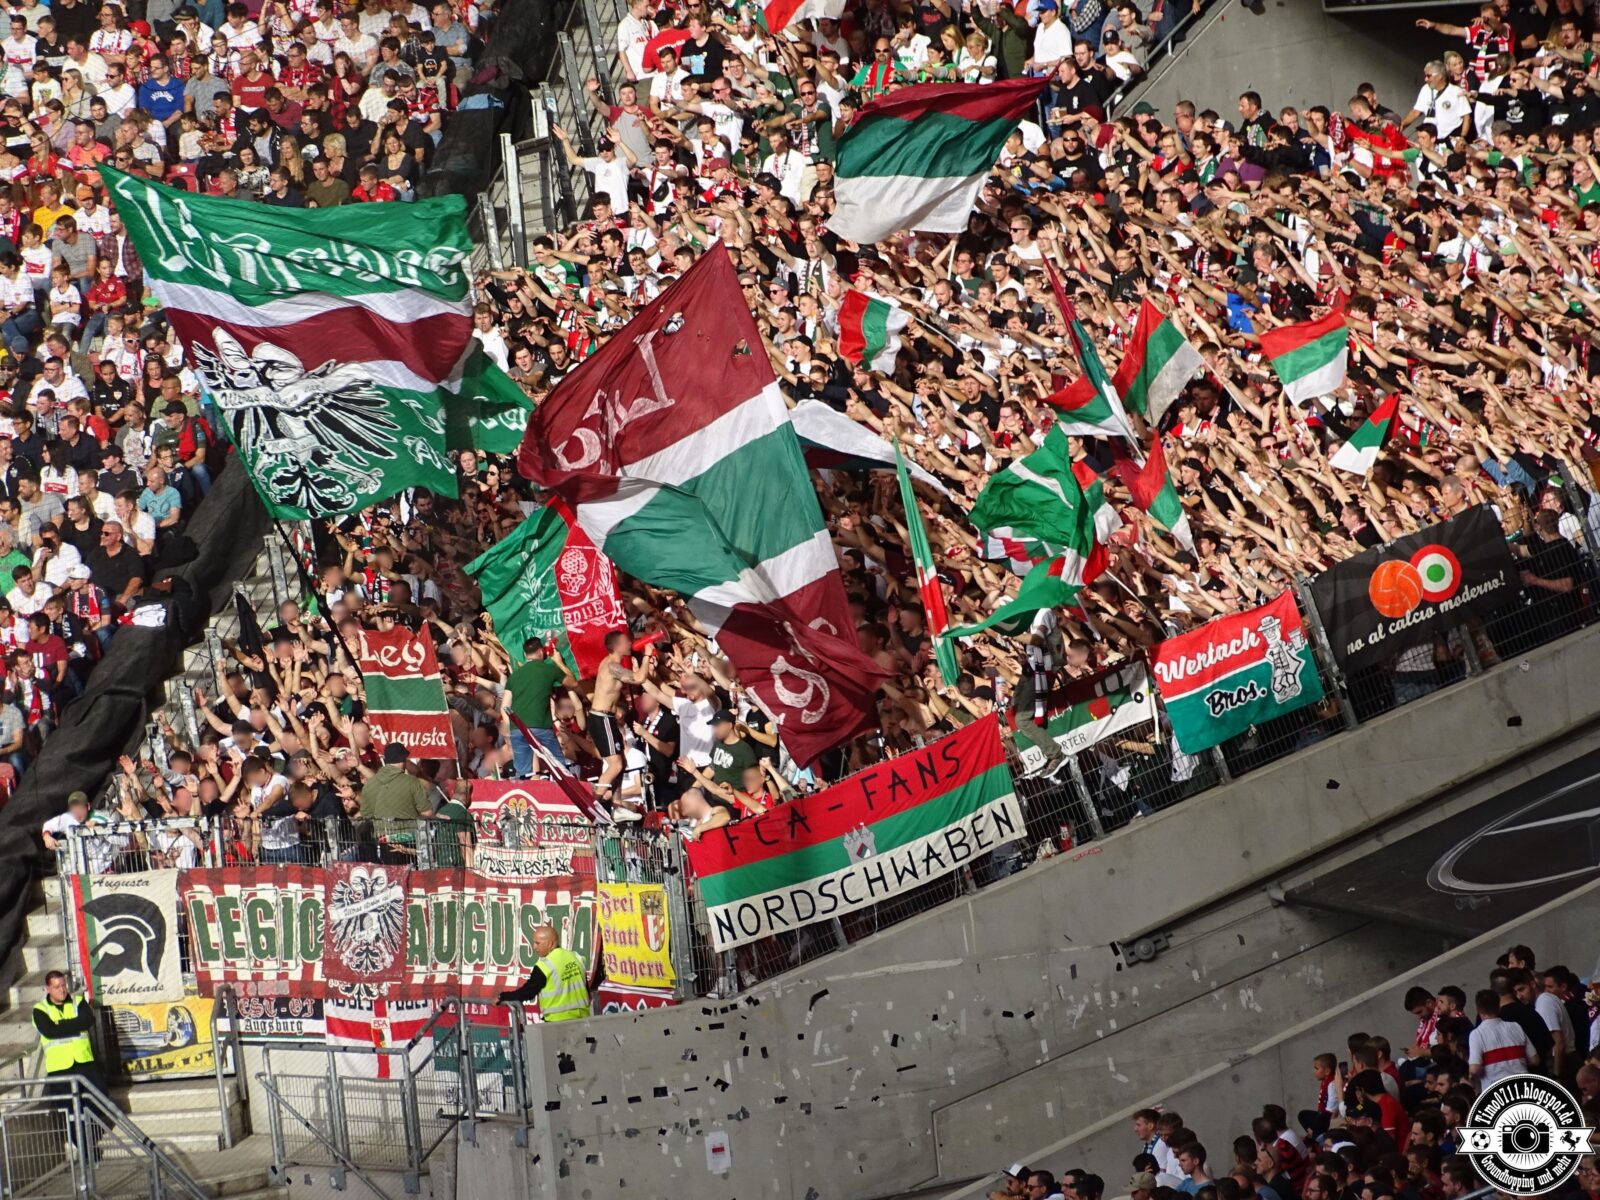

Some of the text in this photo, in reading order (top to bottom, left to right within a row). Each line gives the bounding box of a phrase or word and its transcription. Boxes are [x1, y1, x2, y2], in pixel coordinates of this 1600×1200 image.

[1347, 569, 1506, 656] no al calcio moderno!
[1154, 626, 1261, 684] Wertach
[1204, 679, 1268, 718] Bros.
[370, 724, 448, 747] Augusta
[723, 804, 811, 856] FCA
[860, 740, 962, 811] FANS
[91, 876, 151, 889] Augusta
[714, 802, 1016, 944] NORDSCHWABEN
[599, 889, 636, 920] Frei
[189, 896, 593, 970] LEGIO AUGUSTA
[604, 922, 639, 947] statt
[94, 982, 165, 997] Skinheads
[244, 1017, 304, 1035] Augsburg
